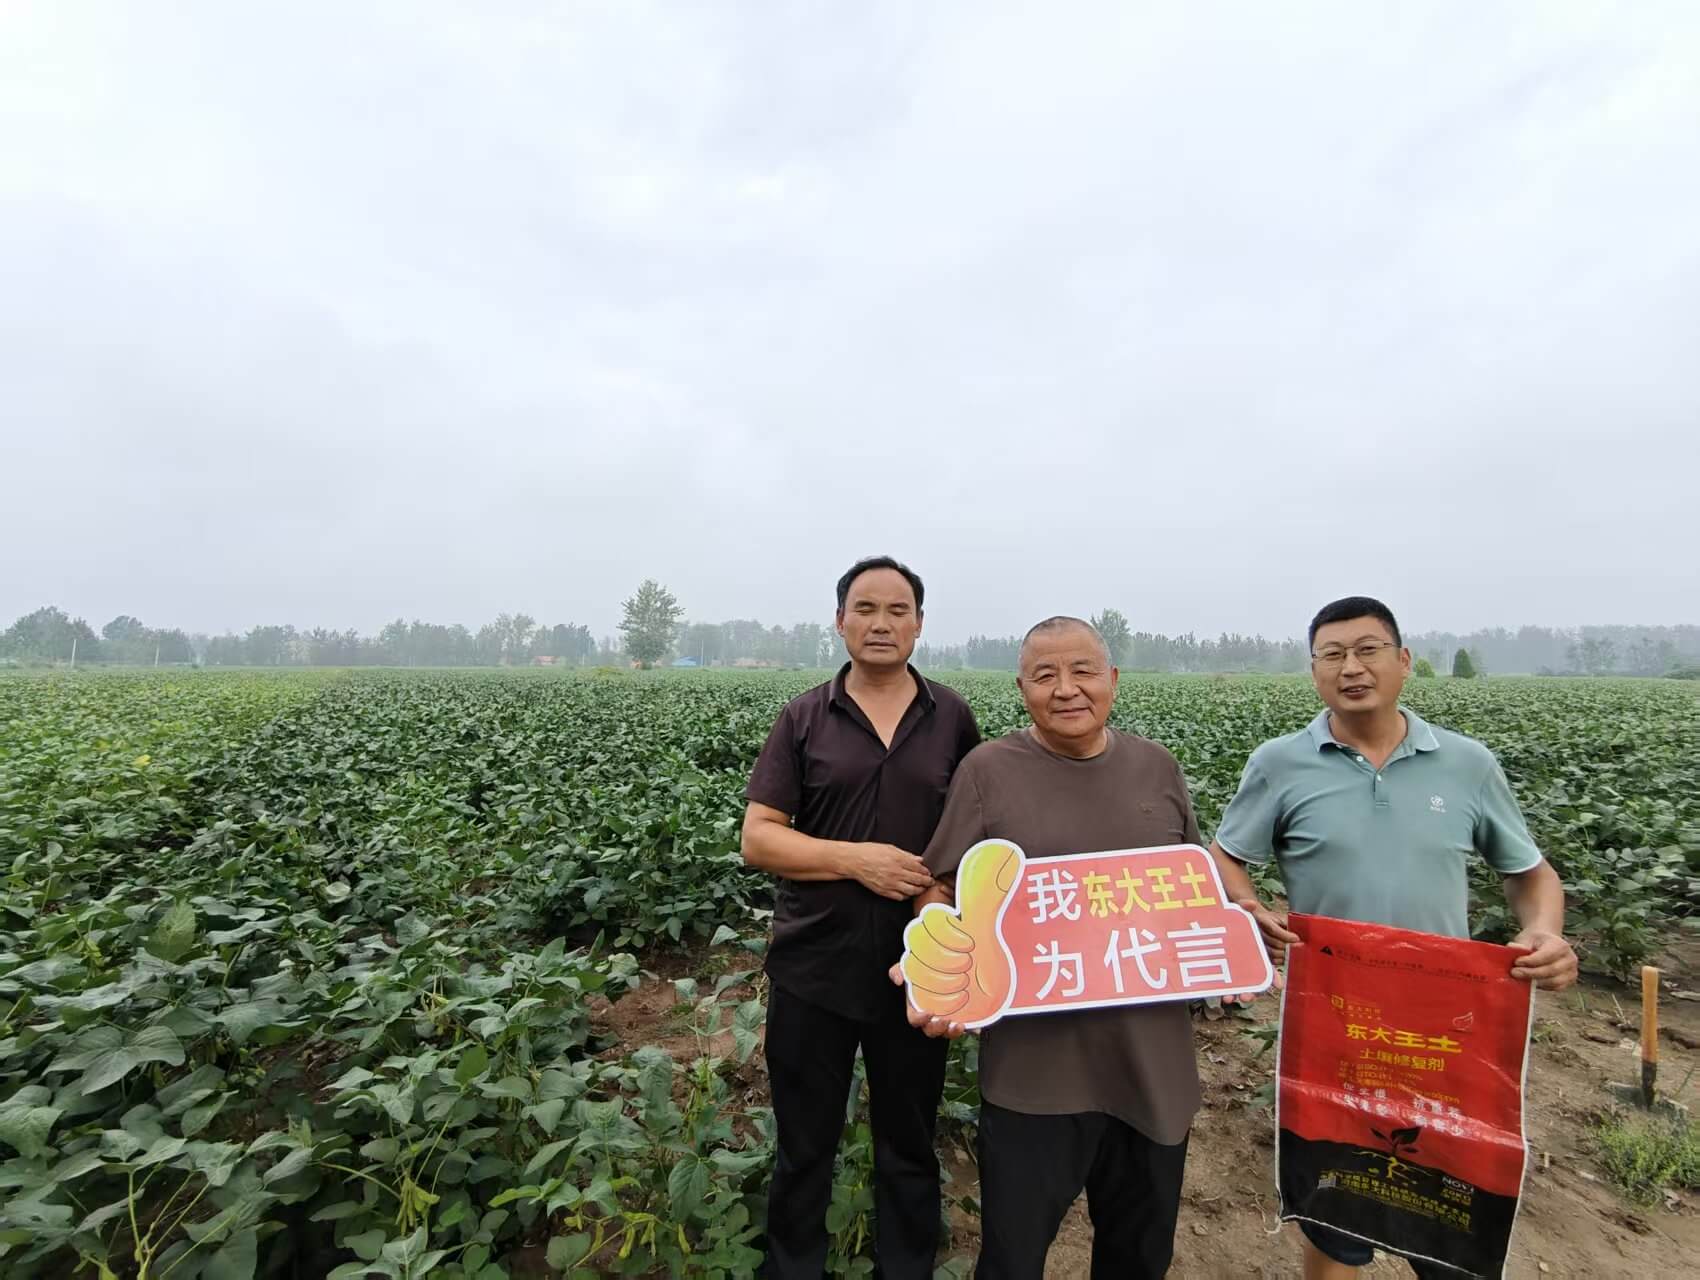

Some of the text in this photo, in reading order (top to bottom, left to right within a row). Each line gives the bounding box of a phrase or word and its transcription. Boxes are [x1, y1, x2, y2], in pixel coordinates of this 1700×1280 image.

[1032, 921, 1233, 1000] 为代言
[1345, 1023, 1462, 1054] 东大王土
